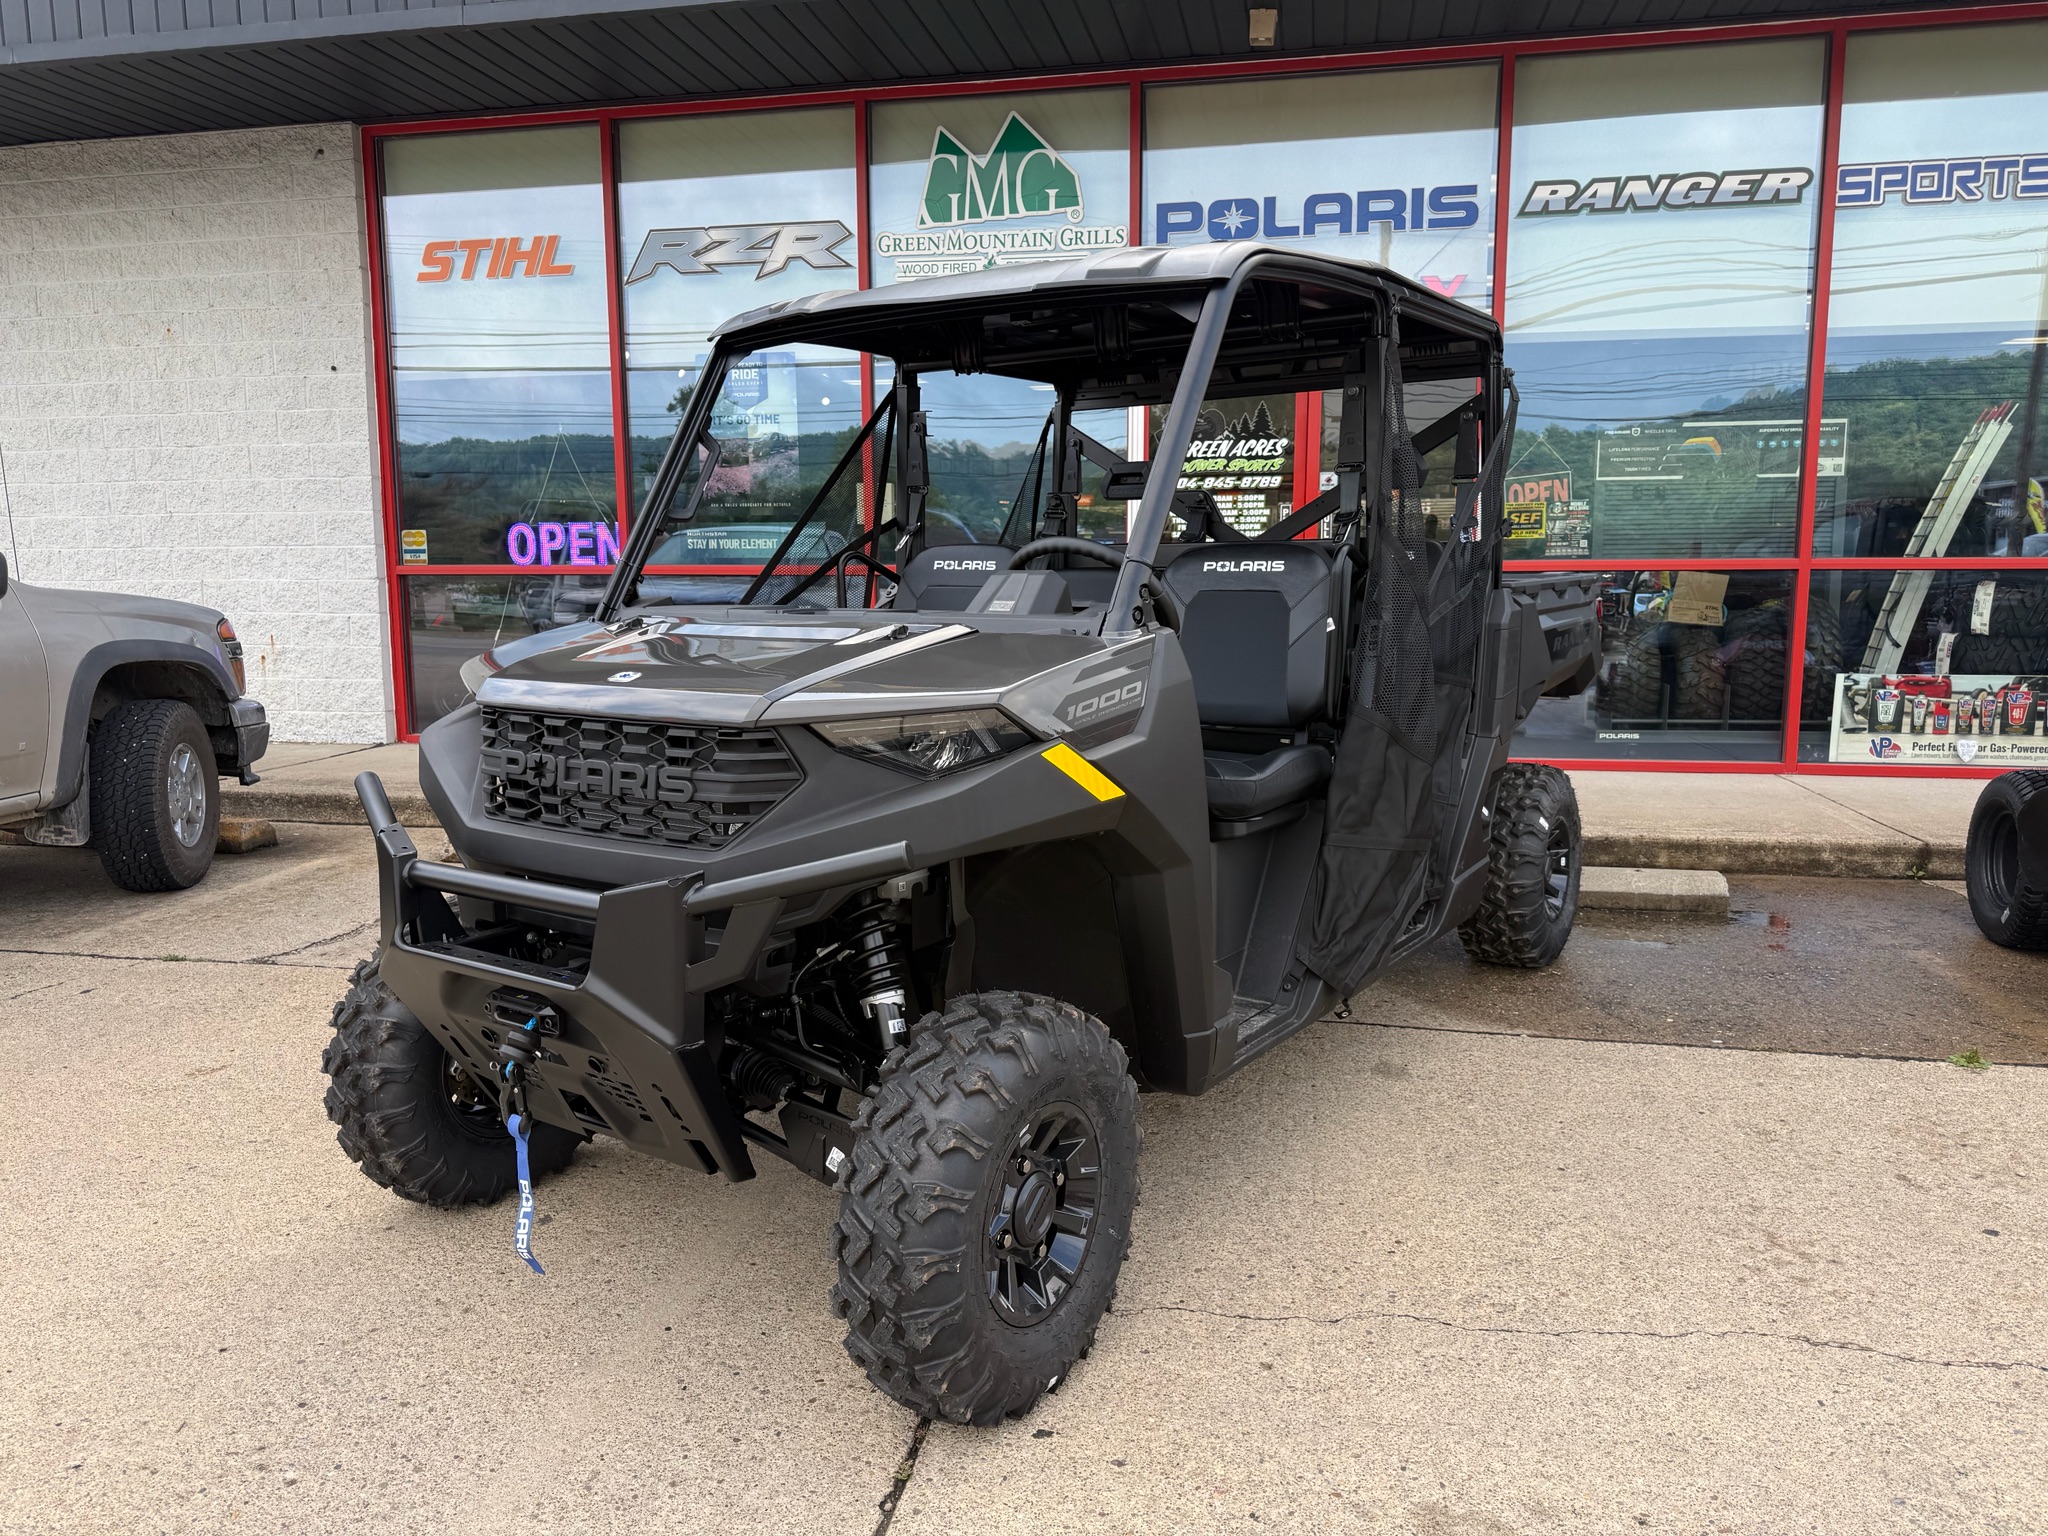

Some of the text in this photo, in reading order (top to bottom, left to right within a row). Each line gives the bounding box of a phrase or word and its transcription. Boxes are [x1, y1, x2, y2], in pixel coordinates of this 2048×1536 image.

[918, 148, 1061, 228] GMG
[1515, 167, 1814, 219] RANGER
[1155, 184, 1480, 245] POLARIS
[878, 227, 1125, 253] GREEN MOUNTAIN GRILLS
[416, 234, 575, 283] STIHL
[625, 219, 856, 287] RZR
[902, 262, 977, 274] WOOD FIRED
[731, 368, 760, 380] RIDE
[736, 415, 751, 425] GO
[753, 413, 780, 425] TIME
[1186, 437, 1290, 458] REEN ACRES
[1226, 457, 1286, 473] SPORTS
[1176, 475, 1283, 489] 04-845-8789
[1510, 512, 1541, 524] SEF
[507, 522, 621, 566] OPEN
[687, 538, 778, 549] STAY IN YOUR ELEMENT
[933, 560, 997, 571] POLARIS
[1202, 559, 1286, 573] POLARIS
[1066, 680, 1142, 721] 1000
[1876, 690, 1893, 701] VP
[2009, 692, 2025, 703] VP
[1870, 736, 1893, 758] VP
[1912, 741, 1946, 752] Perfect
[1948, 742, 1958, 752] Fu
[1978, 744, 1989, 752] or
[499, 748, 696, 802] POLARIS
[516, 1179, 533, 1259] POLARIS
